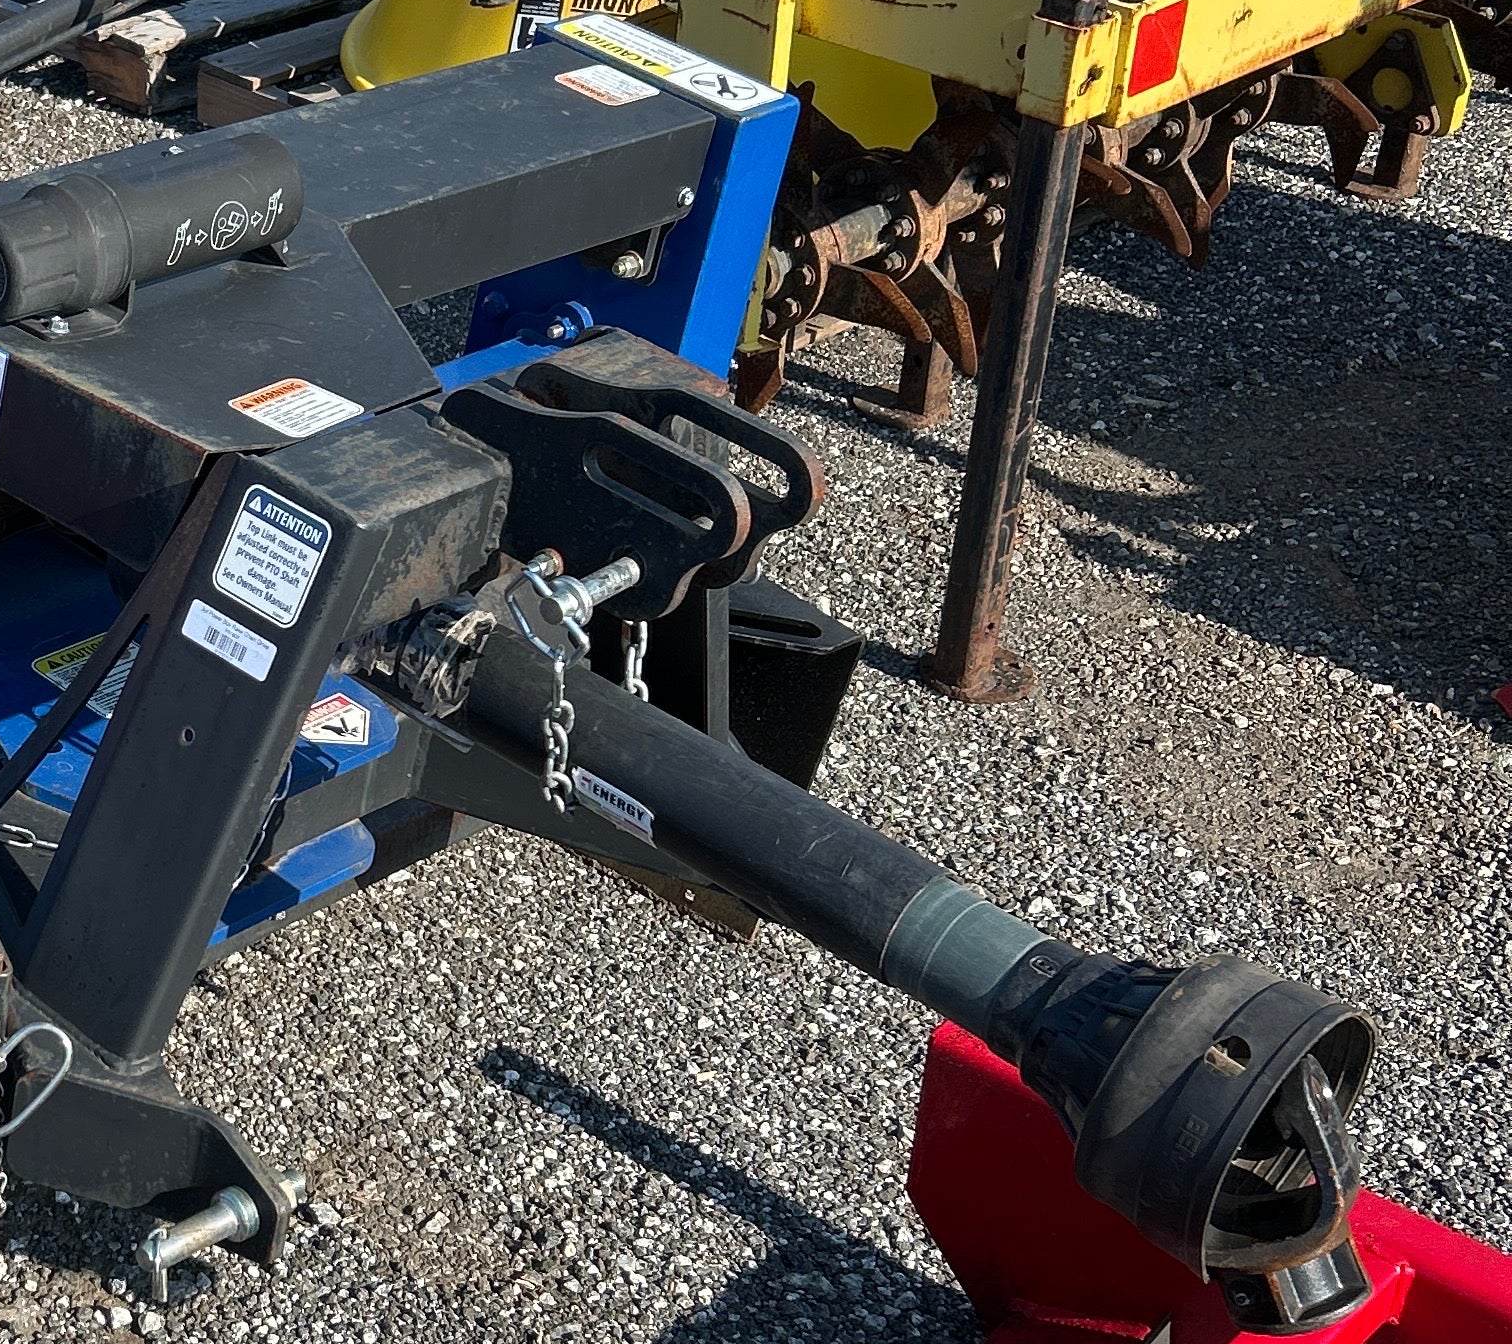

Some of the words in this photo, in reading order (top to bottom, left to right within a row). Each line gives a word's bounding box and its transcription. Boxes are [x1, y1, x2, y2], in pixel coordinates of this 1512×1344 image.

[572, 29, 643, 63] CAUTION
[262, 502, 323, 545] ATTENTION
[235, 547, 265, 569] prevent
[265, 562, 280, 576] PTO
[261, 528, 277, 544] Link
[277, 539, 297, 556] must
[298, 548, 308, 562] be
[235, 575, 264, 598] Owners
[60, 640, 103, 664] CAUTIO
[592, 782, 646, 822] ENERGY
